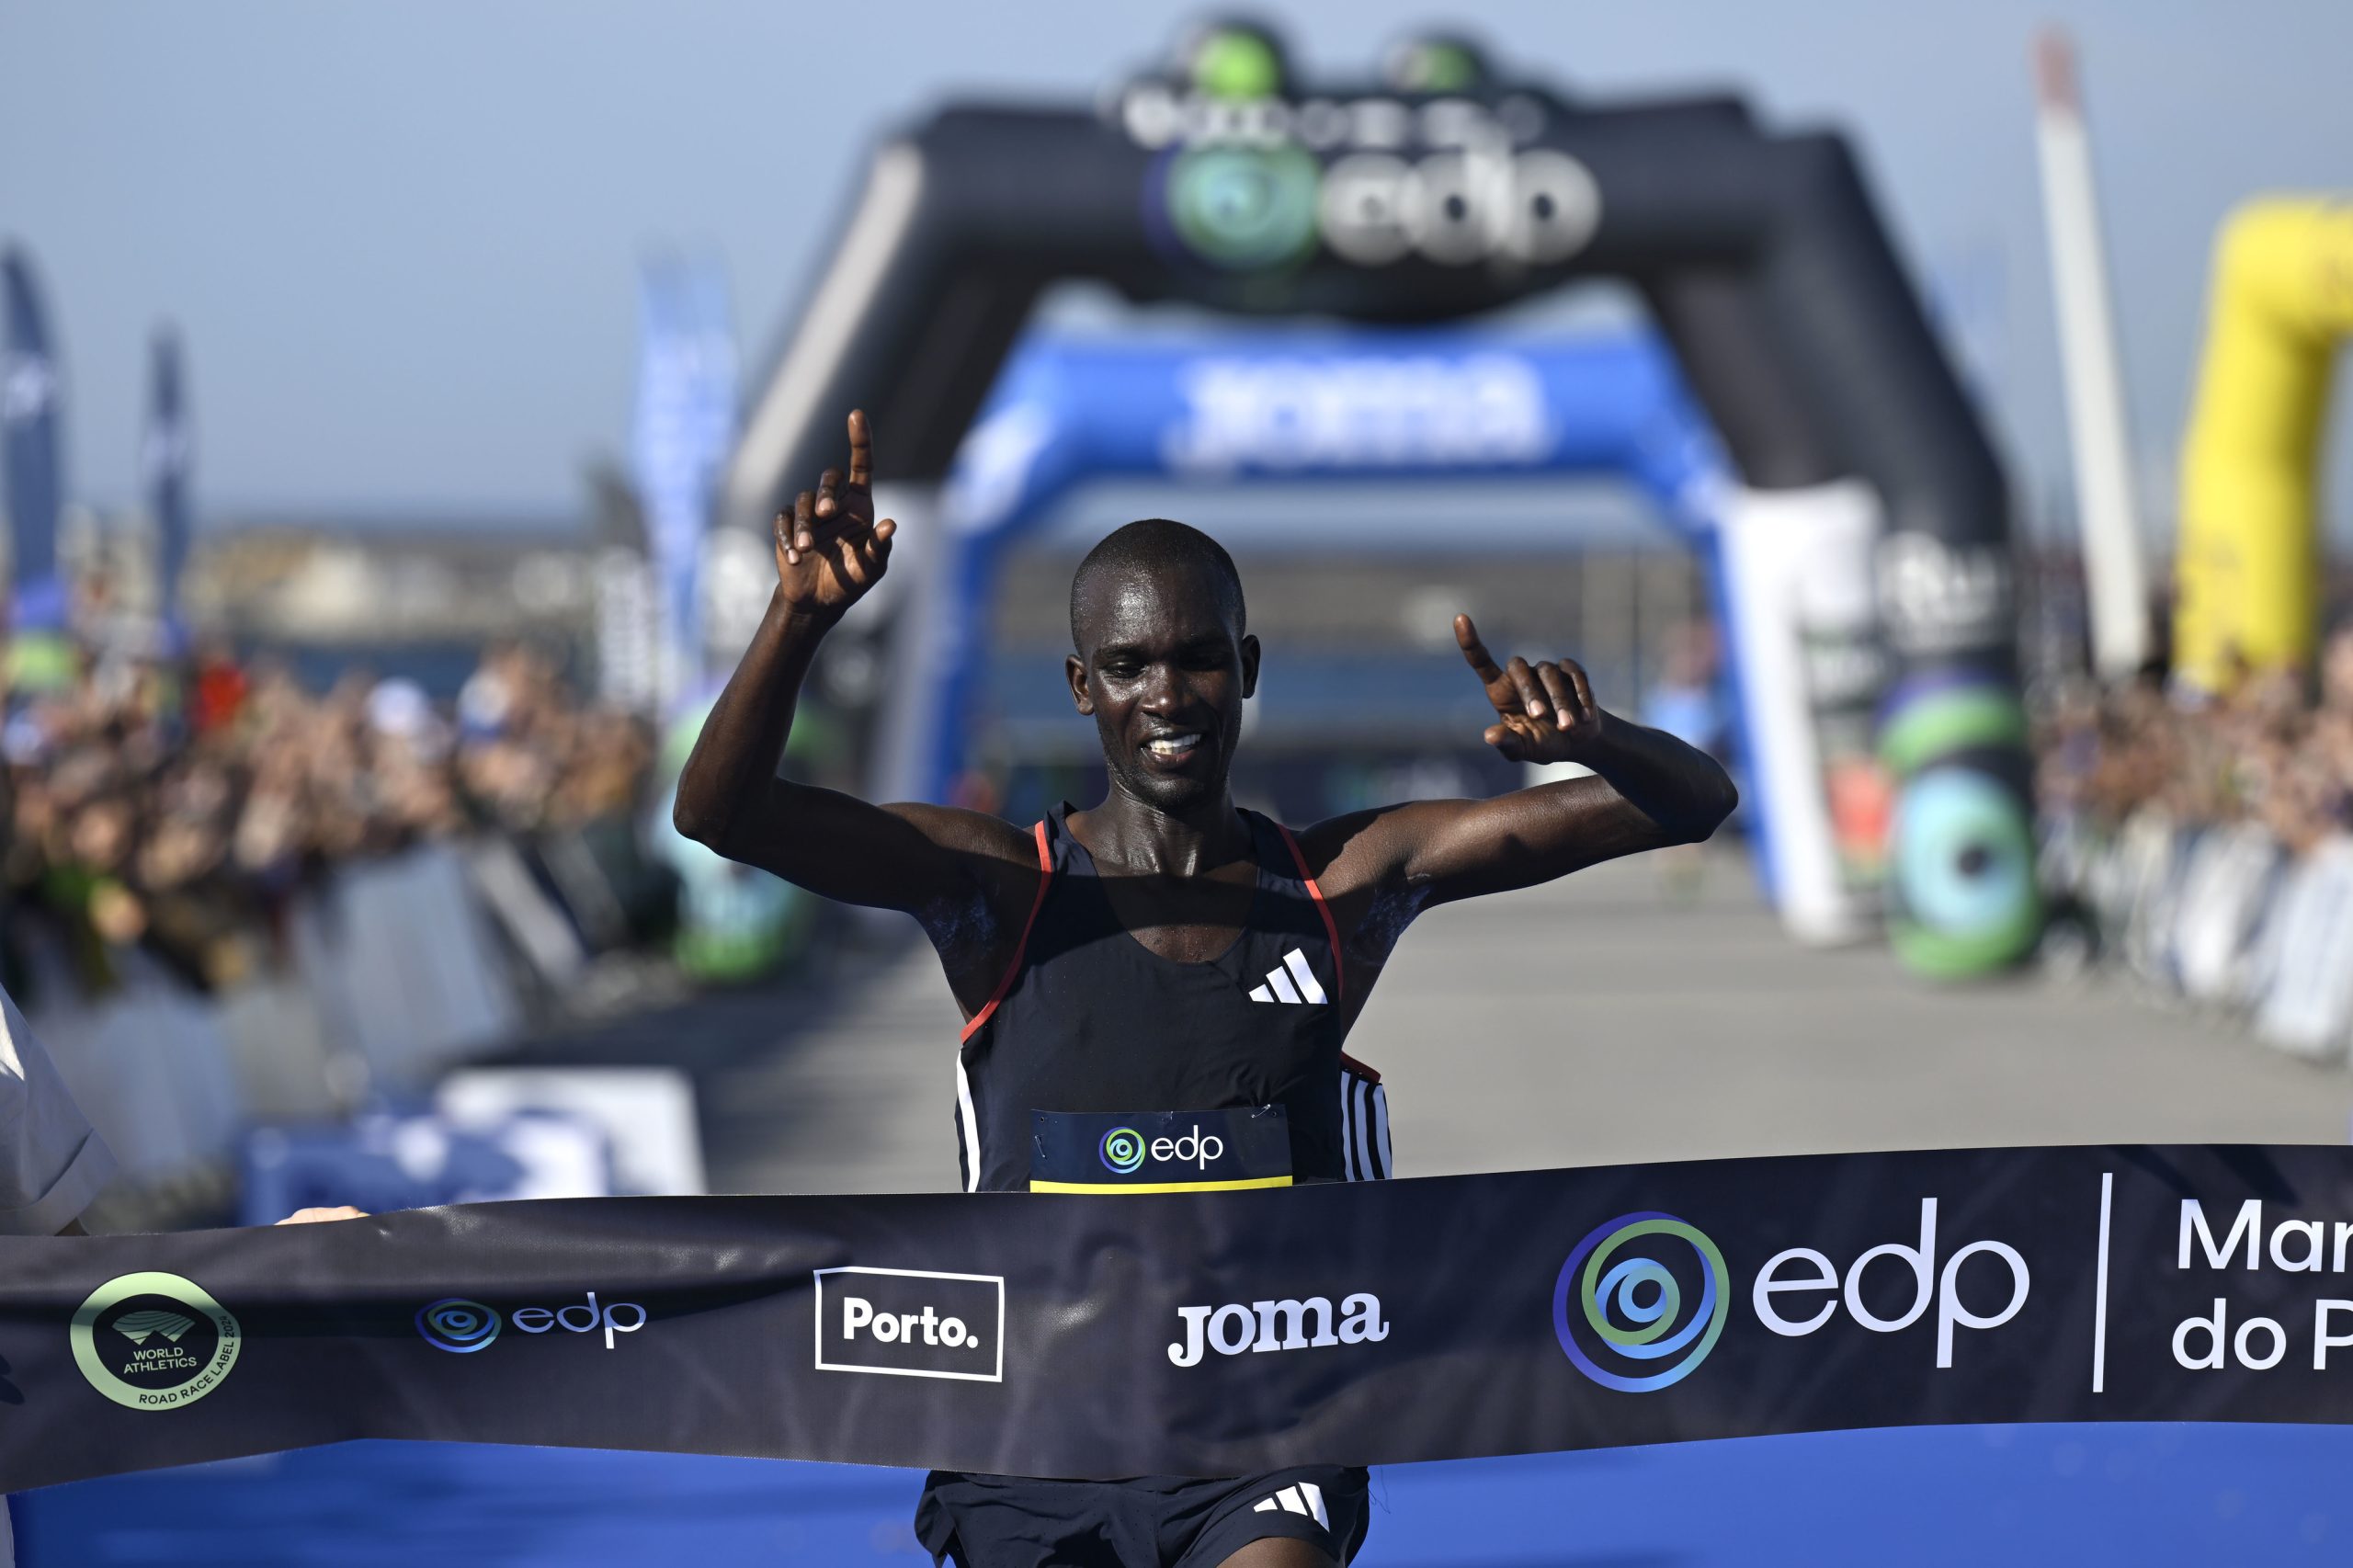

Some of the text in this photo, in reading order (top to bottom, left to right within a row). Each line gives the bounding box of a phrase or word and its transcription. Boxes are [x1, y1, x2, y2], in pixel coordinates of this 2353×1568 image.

[1320, 124, 1602, 276] edp
[1149, 1124, 1224, 1170] edp
[1752, 1197, 2030, 1369] edp
[513, 1291, 647, 1349] edp
[843, 1296, 979, 1349] Porto.
[2172, 1298, 2287, 1370] do
[123, 1357, 198, 1375] ATHLETICS
[133, 1346, 184, 1360] WORLD
[138, 1392, 177, 1404] ROAD
[180, 1375, 213, 1398] RACE
[210, 1341, 234, 1377] LABEL
